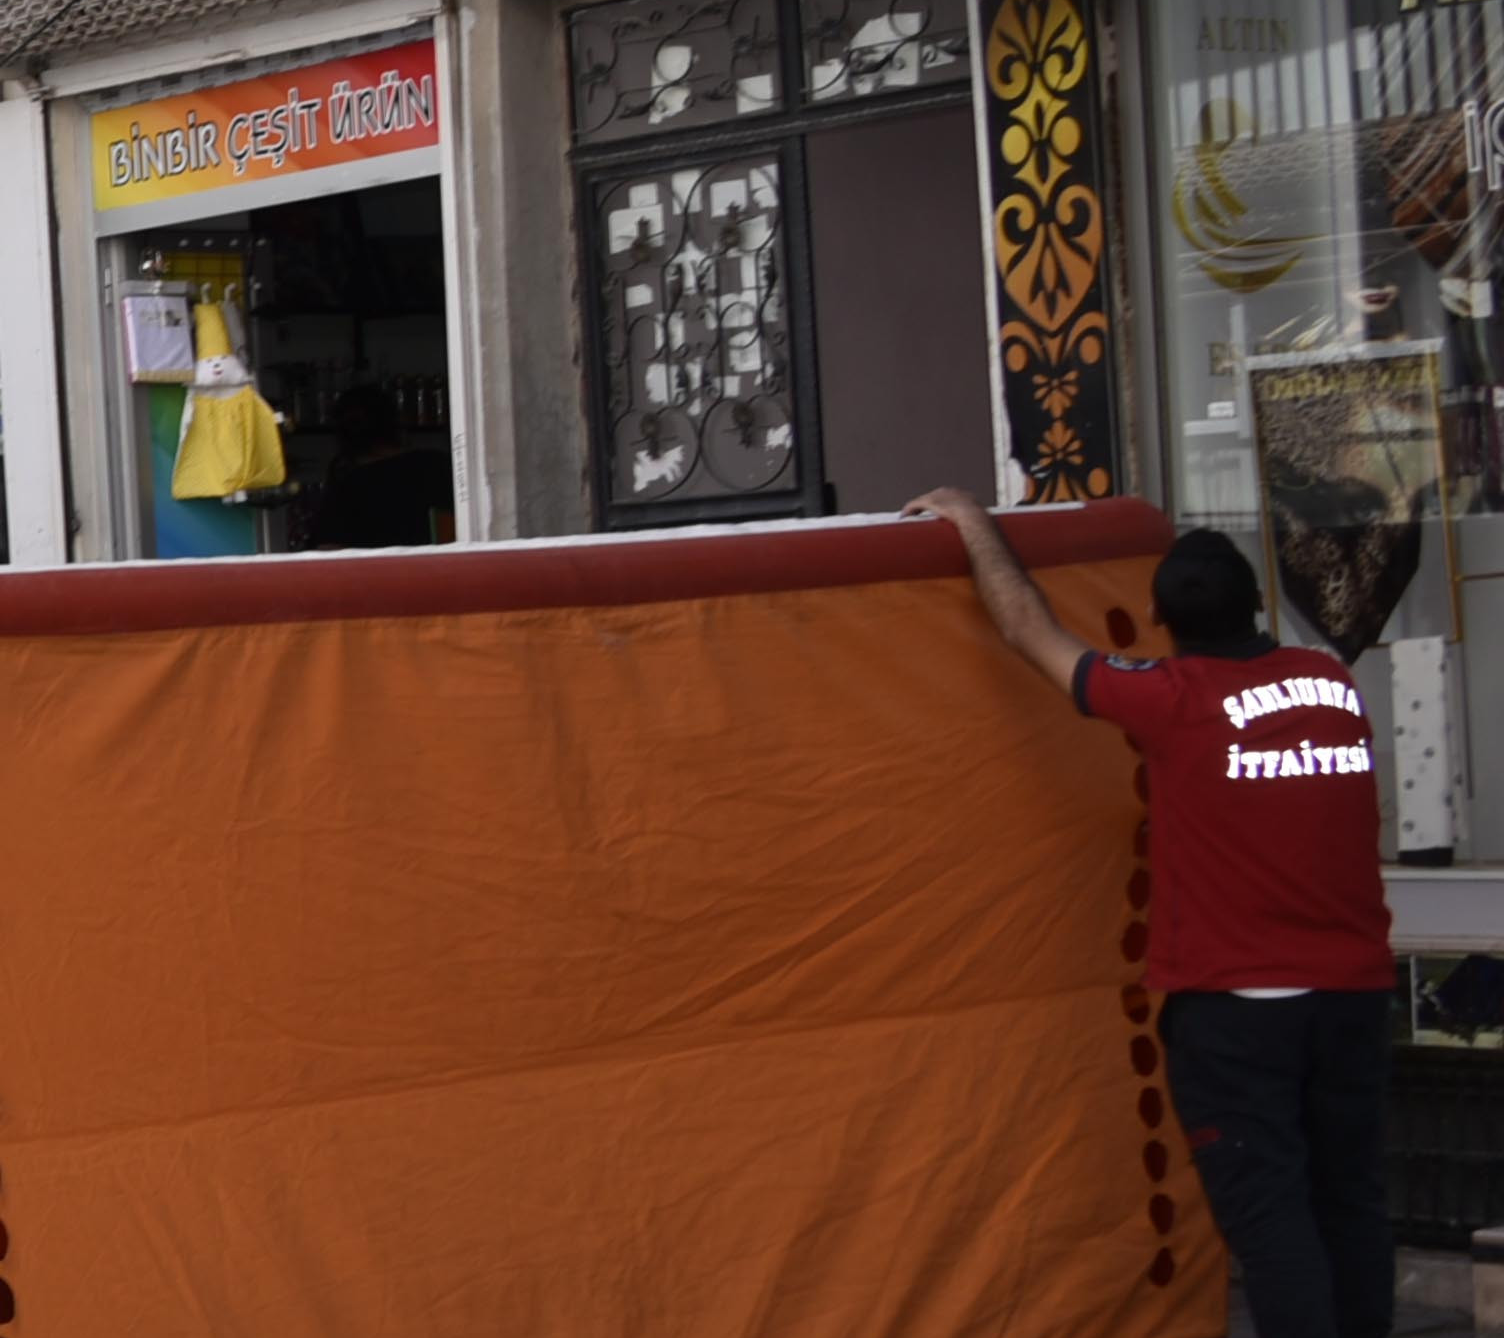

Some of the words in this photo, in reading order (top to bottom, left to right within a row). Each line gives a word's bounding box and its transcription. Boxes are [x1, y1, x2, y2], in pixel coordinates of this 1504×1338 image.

[109, 108, 221, 187] BİNBİR
[227, 88, 321, 177] ÇEŞİT
[329, 70, 434, 145] ÜRÜN
